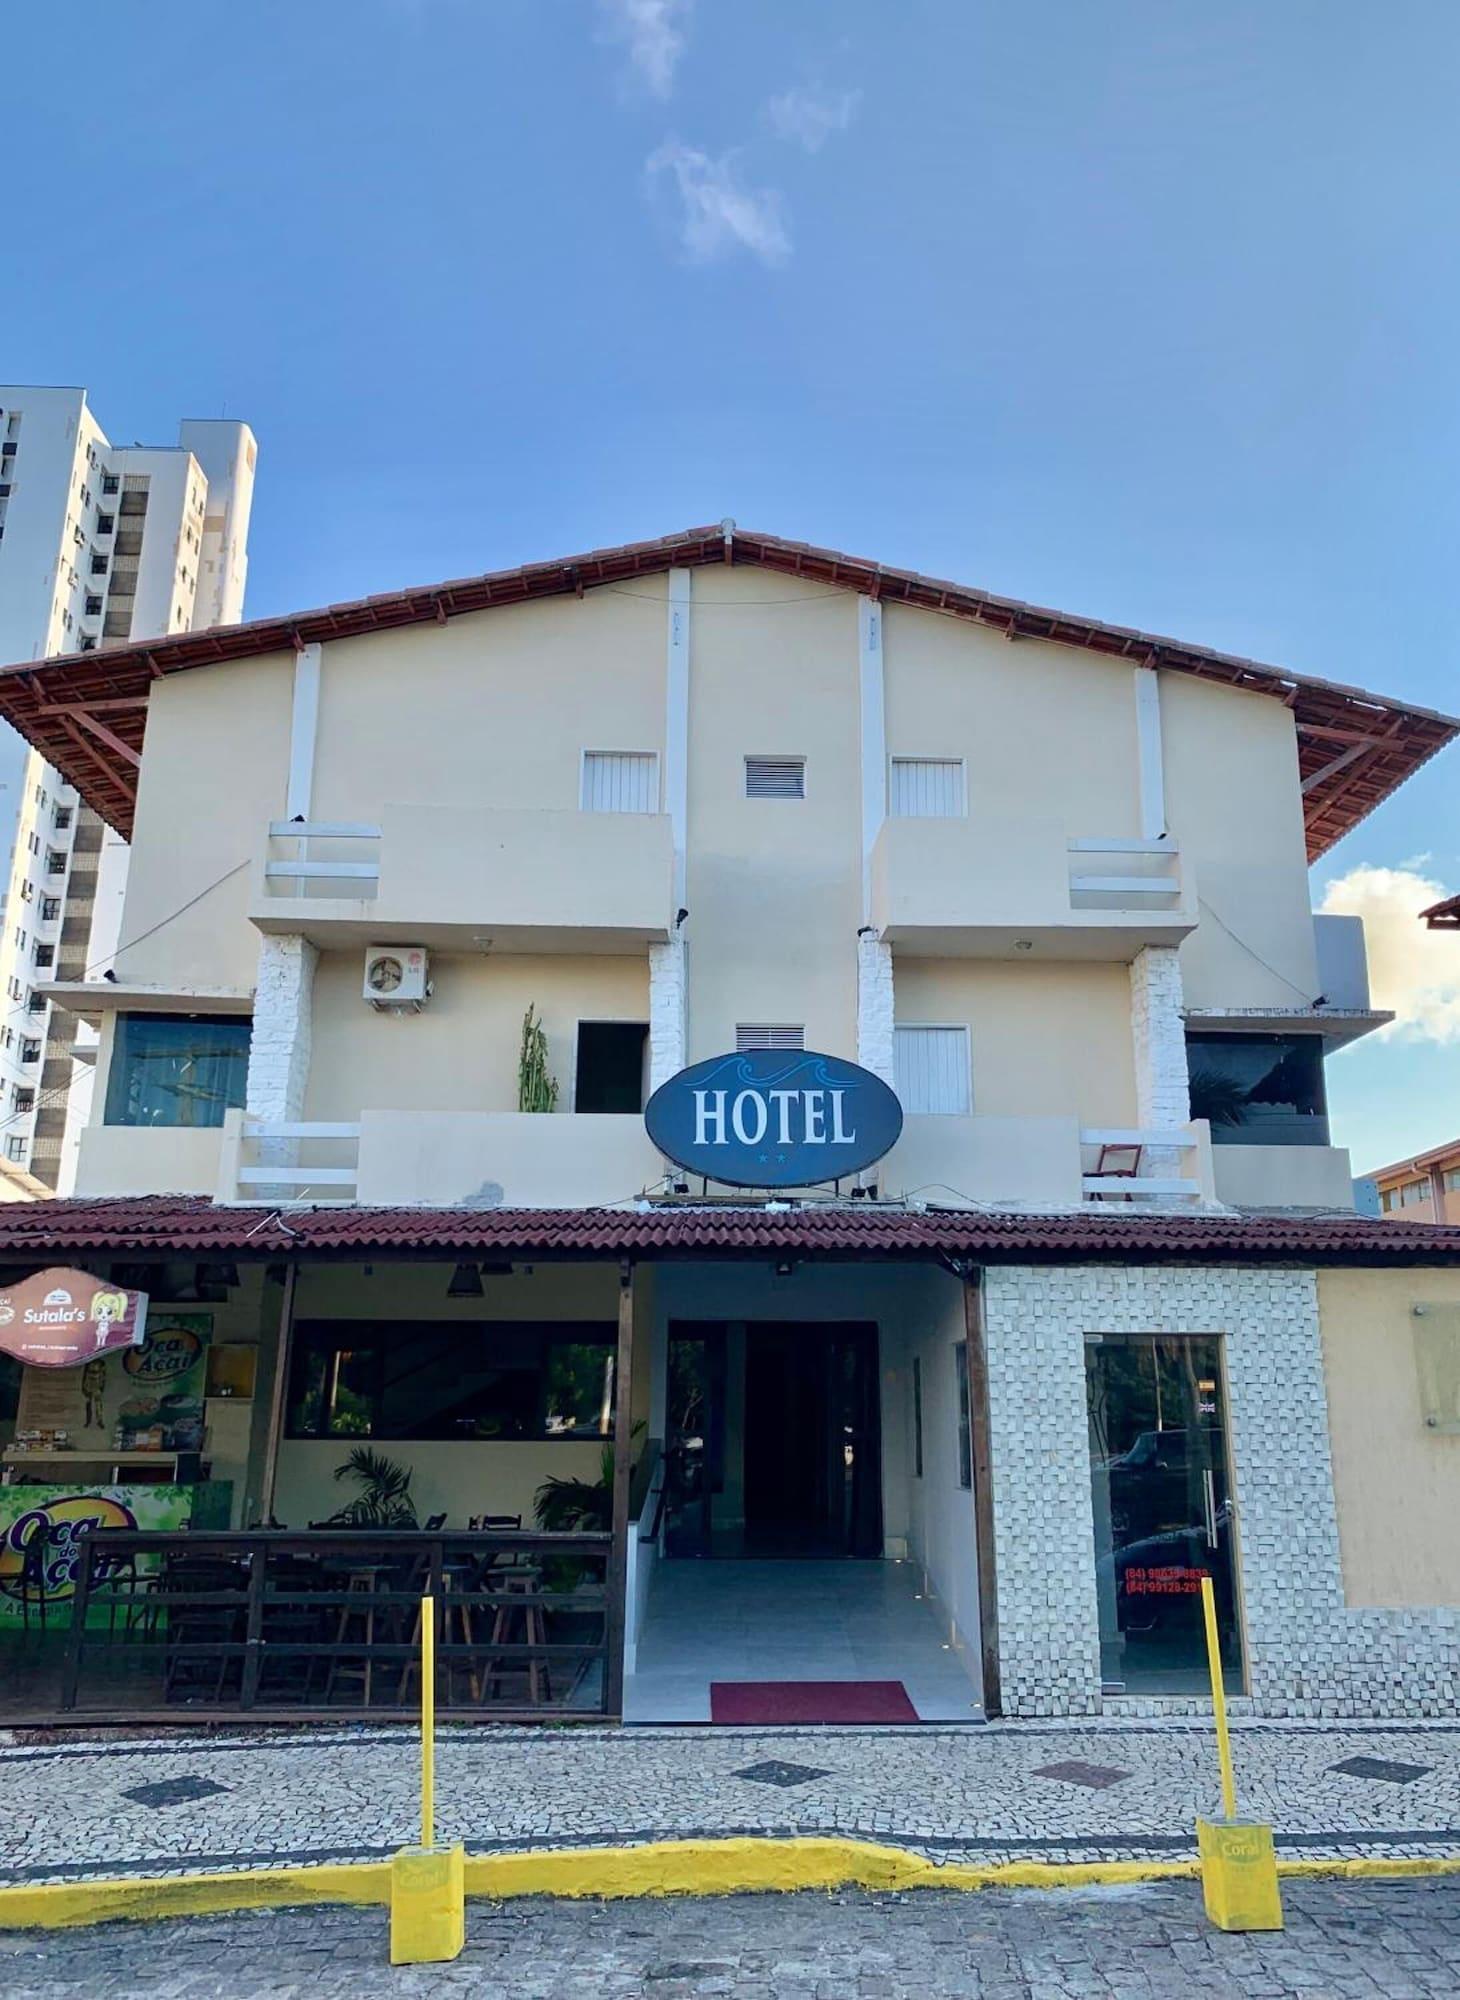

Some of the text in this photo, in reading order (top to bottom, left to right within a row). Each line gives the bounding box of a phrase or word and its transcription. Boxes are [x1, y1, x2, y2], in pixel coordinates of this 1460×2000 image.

[693, 1089, 856, 1145] HOTEL
[24, 1308, 86, 1323] Sutala's
[9, 1511, 101, 1552] Oca
[59, 1547, 78, 1558] do
